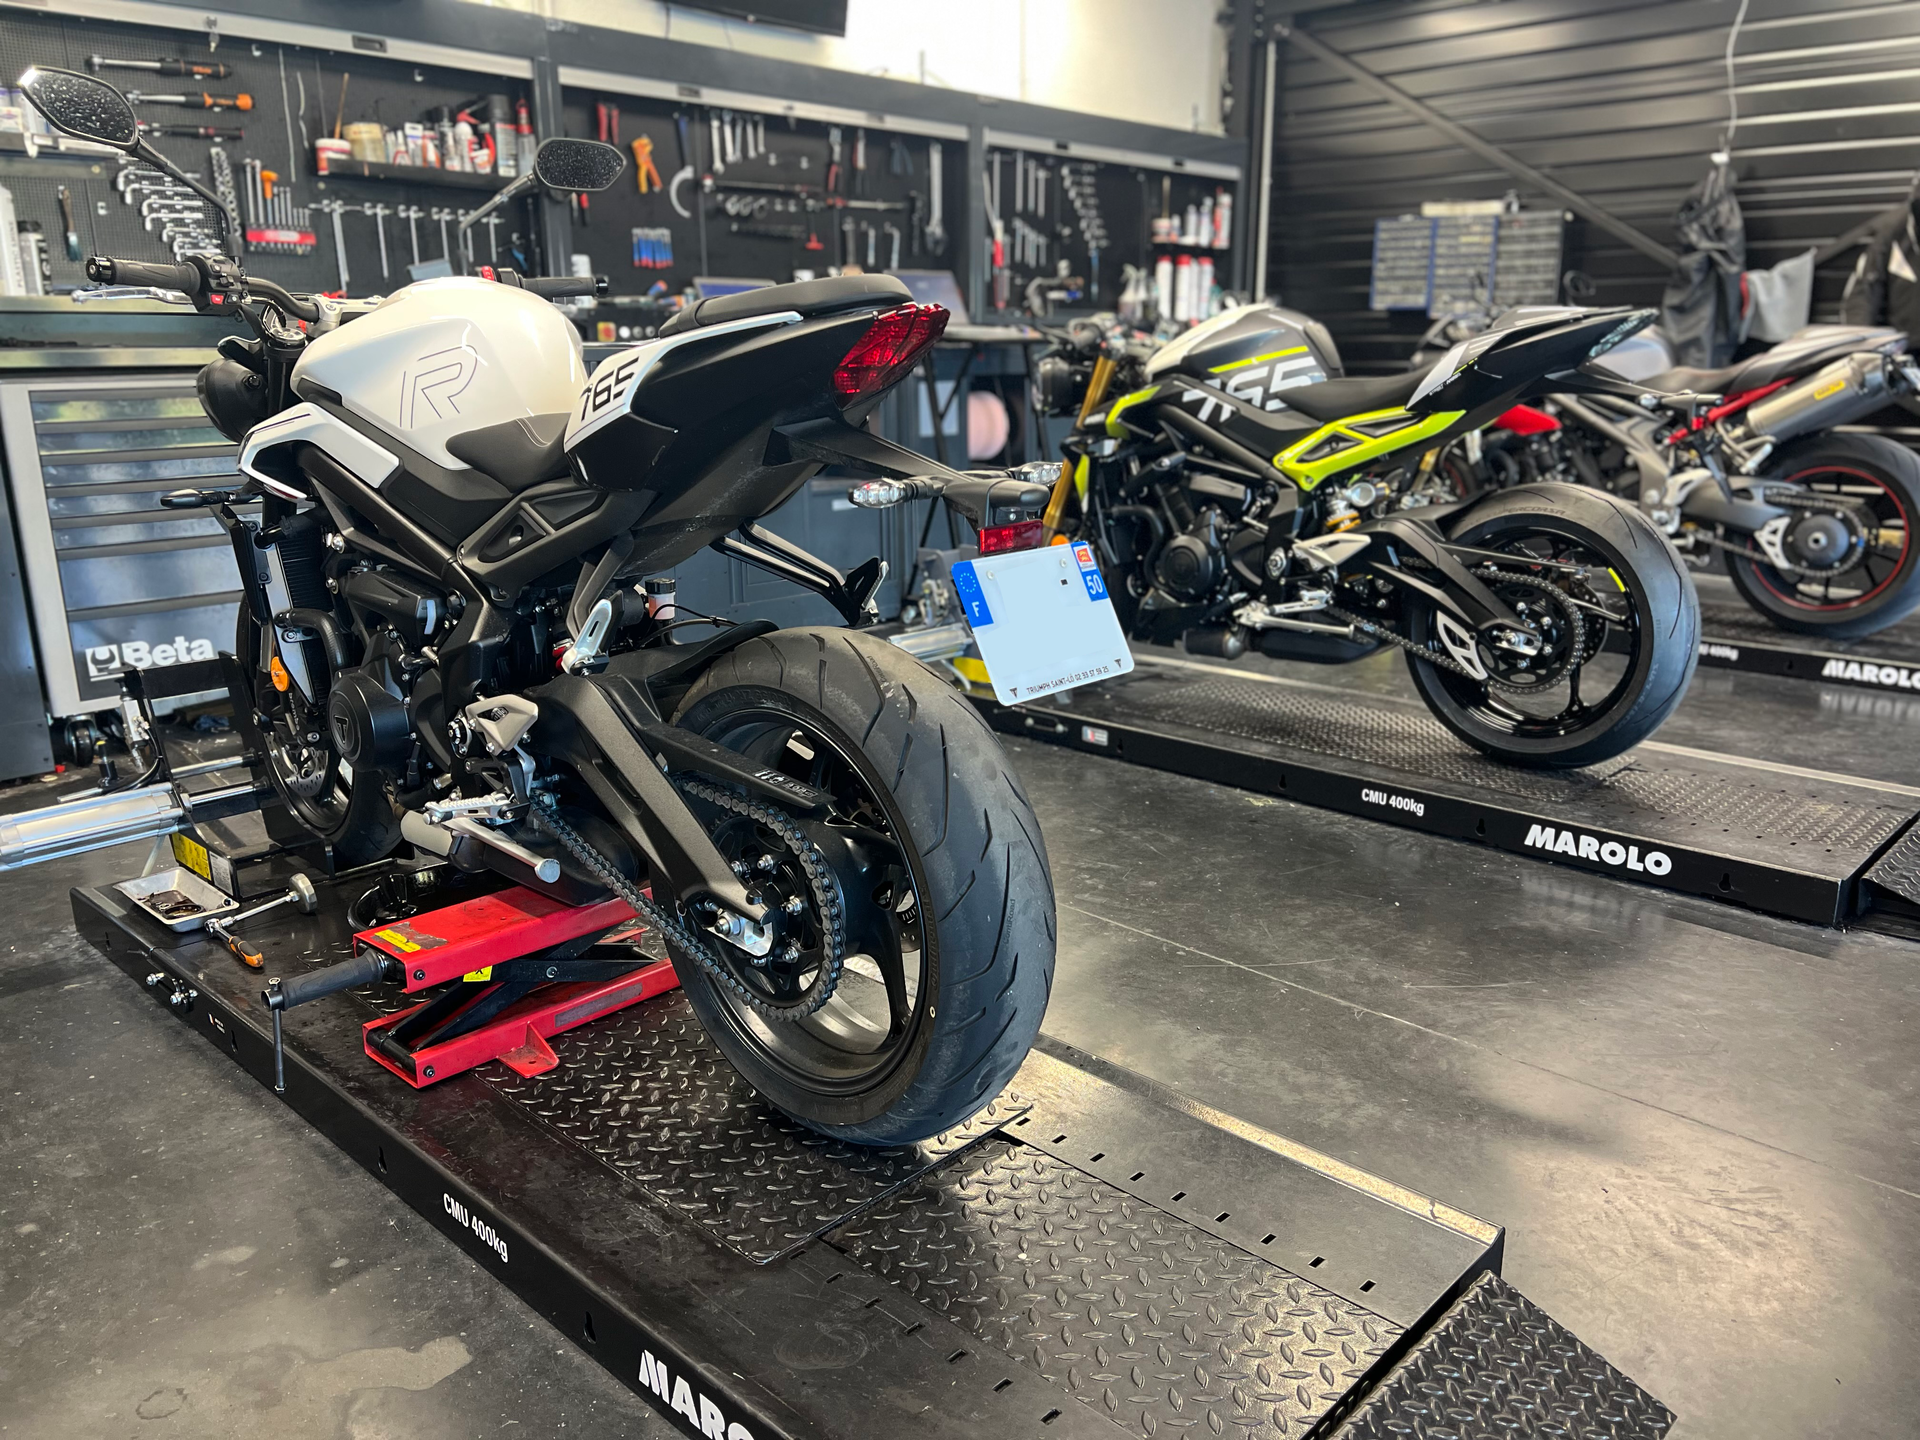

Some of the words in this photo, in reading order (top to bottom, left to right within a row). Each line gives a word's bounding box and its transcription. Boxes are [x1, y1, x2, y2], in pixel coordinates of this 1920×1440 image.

[399, 344, 478, 430] R
[580, 356, 640, 423] 765
[1086, 574, 1104, 595] 50
[971, 601, 980, 617] F
[121, 635, 215, 669] Beta
[1026, 681, 1051, 695] TRIUMPH
[1050, 673, 1075, 688] SAINT-LÔ
[1074, 673, 1082, 682] 02
[1081, 671, 1090, 680] 33
[1089, 669, 1096, 677] 57
[1102, 665, 1110, 673] 25
[1361, 788, 1388, 806] CMU
[1389, 794, 1425, 817] 400kg
[1524, 824, 1673, 876] MAROLO
[1003, 898, 1016, 945] ContiRoad
[443, 1192, 469, 1228] CMU
[471, 1215, 509, 1263] 400kg
